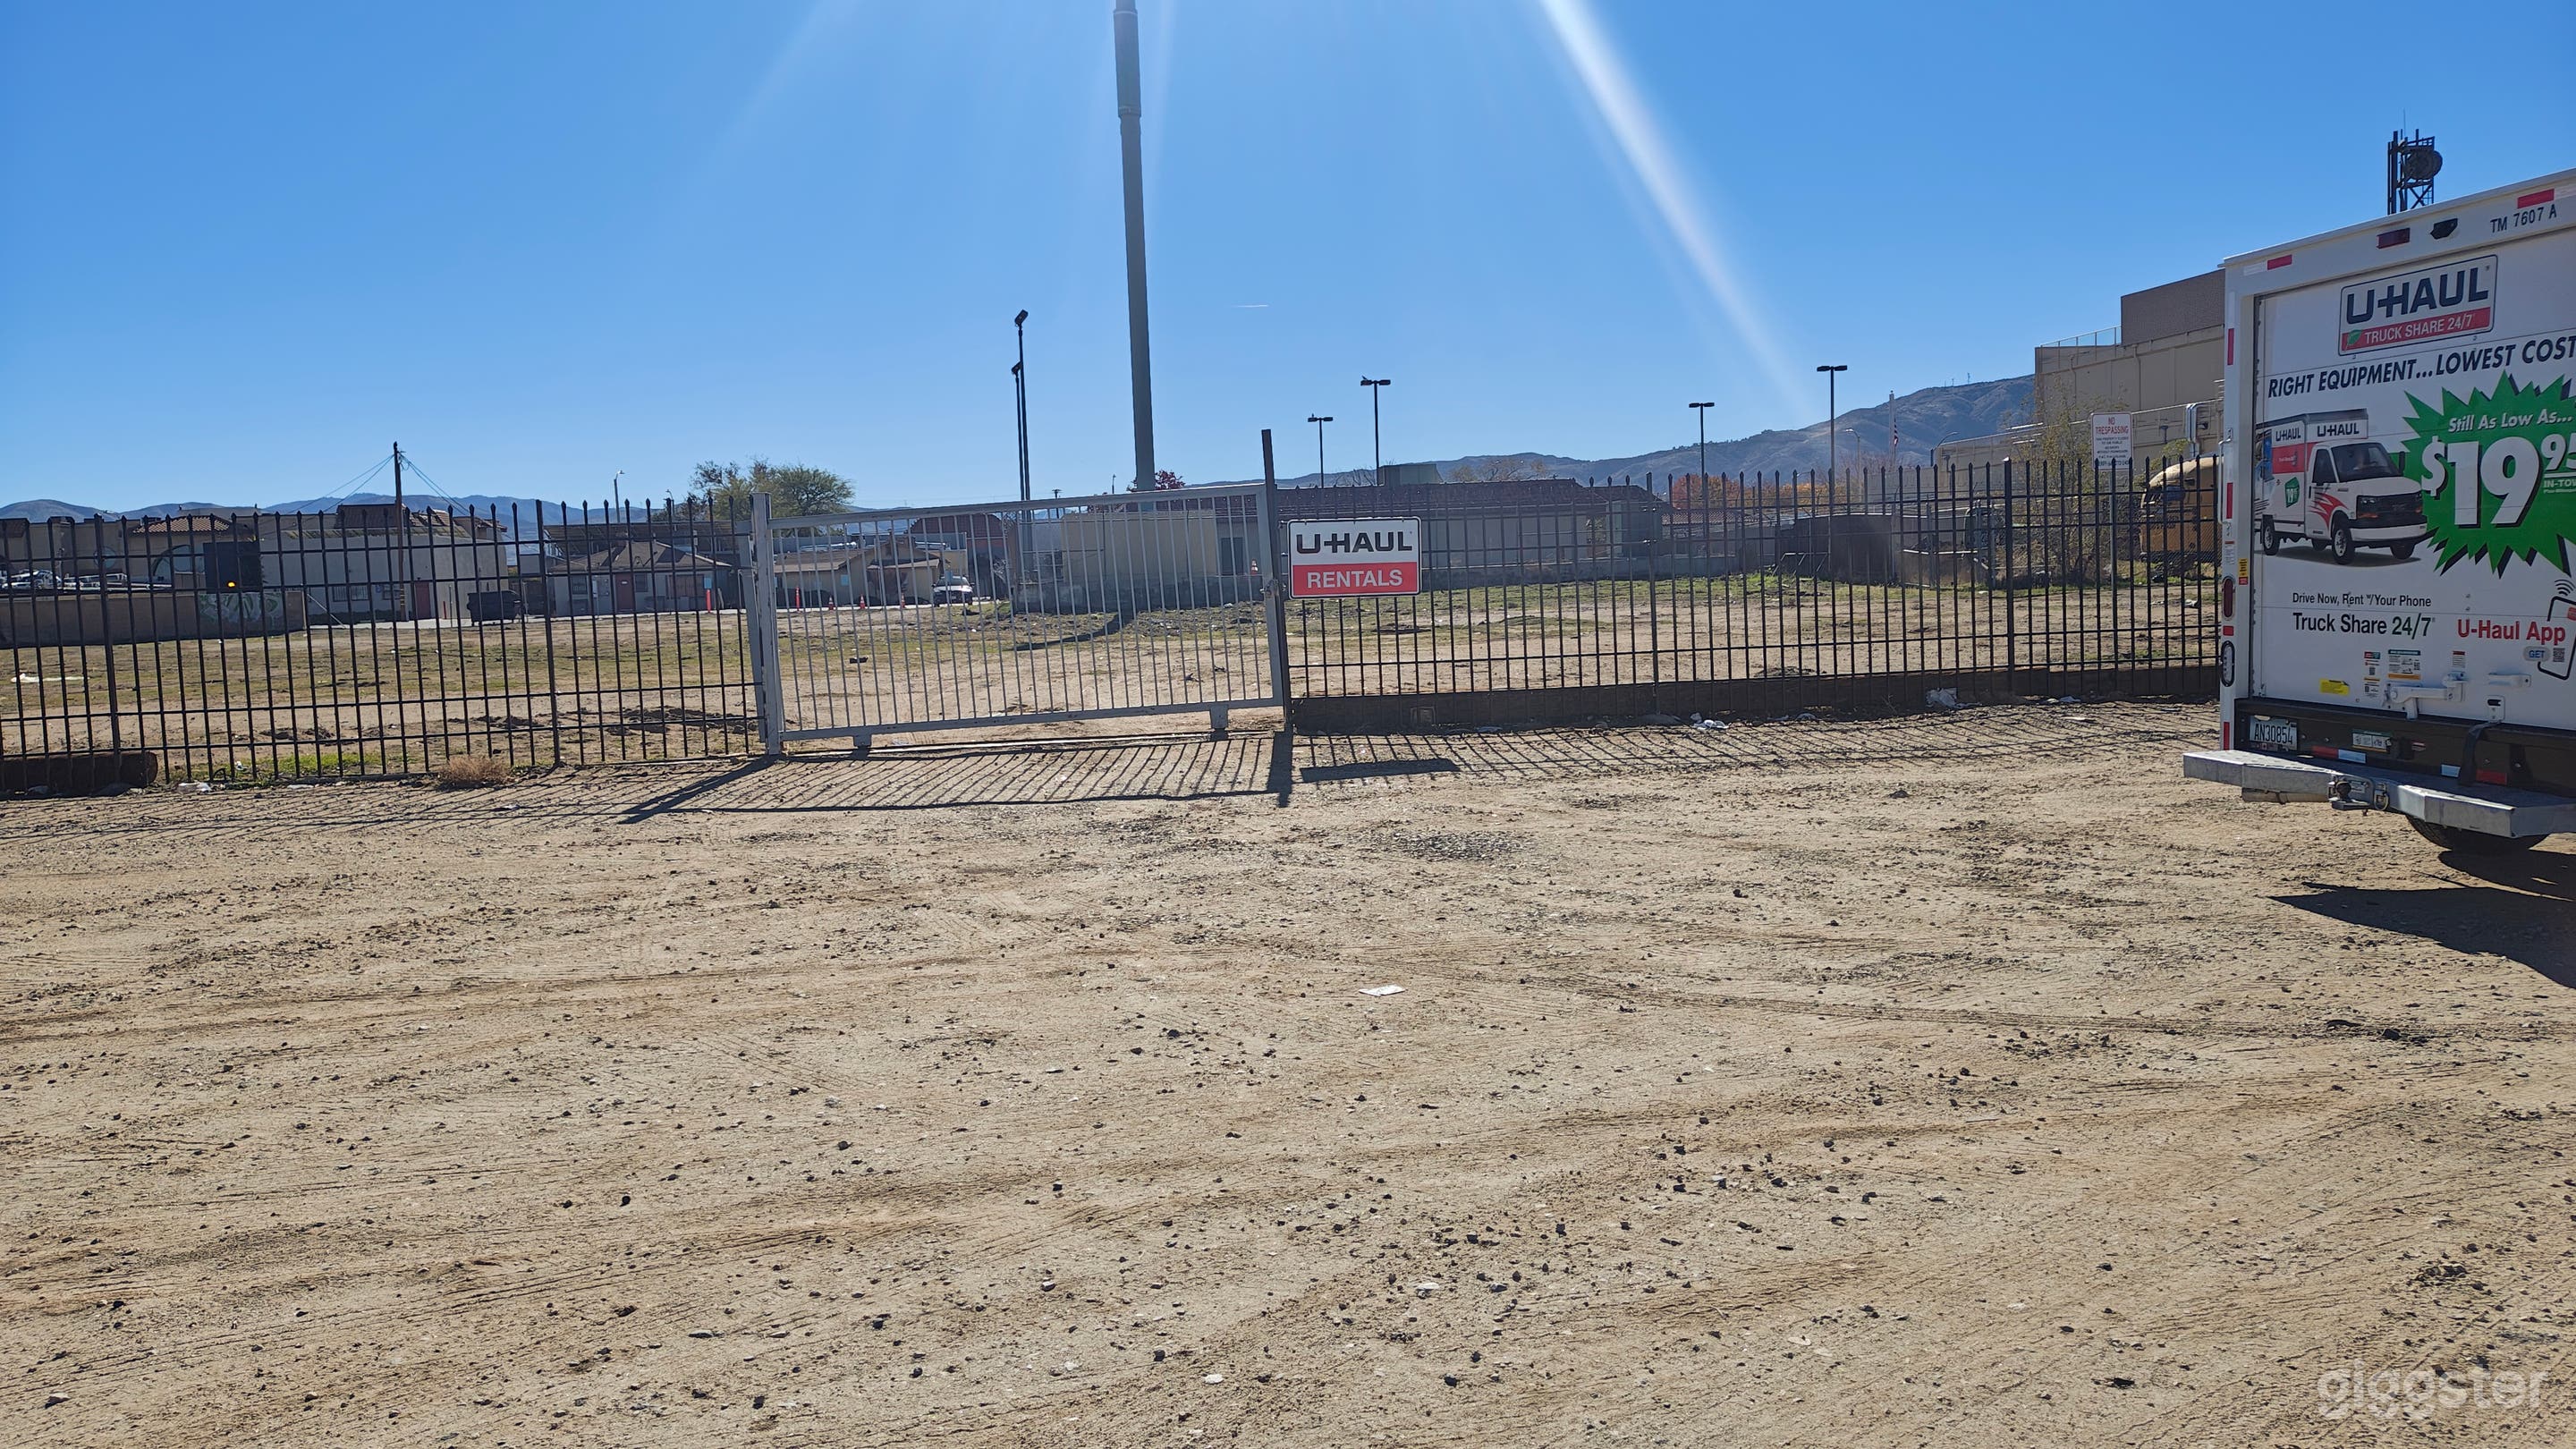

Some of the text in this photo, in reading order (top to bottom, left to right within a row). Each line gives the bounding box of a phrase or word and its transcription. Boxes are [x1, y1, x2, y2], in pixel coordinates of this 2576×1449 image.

[2490, 204, 2557, 233] TM 7607 A
[2346, 267, 2489, 325] U-HAUL
[2365, 314, 2473, 344] TRUCK SHARE 24/7
[2267, 373, 2315, 399] RIGHT
[2521, 335, 2576, 364] COST
[2095, 426, 2129, 435] TRESPASSING
[2107, 417, 2115, 425] NO
[2317, 422, 2360, 437] U-HAUL
[2448, 408, 2573, 433] Still As Low As...
[2275, 427, 2301, 442] U-HAUL
[1296, 531, 1413, 555] U-HAUL
[1307, 569, 1403, 589] RENTALS
[2292, 592, 2315, 604] Drive
[2318, 593, 2340, 606] Now,
[2342, 593, 2364, 605] Rent
[2399, 595, 2432, 607] Phone
[2292, 612, 2432, 640] Truck Share 24/7
[2457, 618, 2566, 646] U-Haul App
[2529, 649, 2546, 658] GET
[2254, 723, 2293, 745] AN30854
